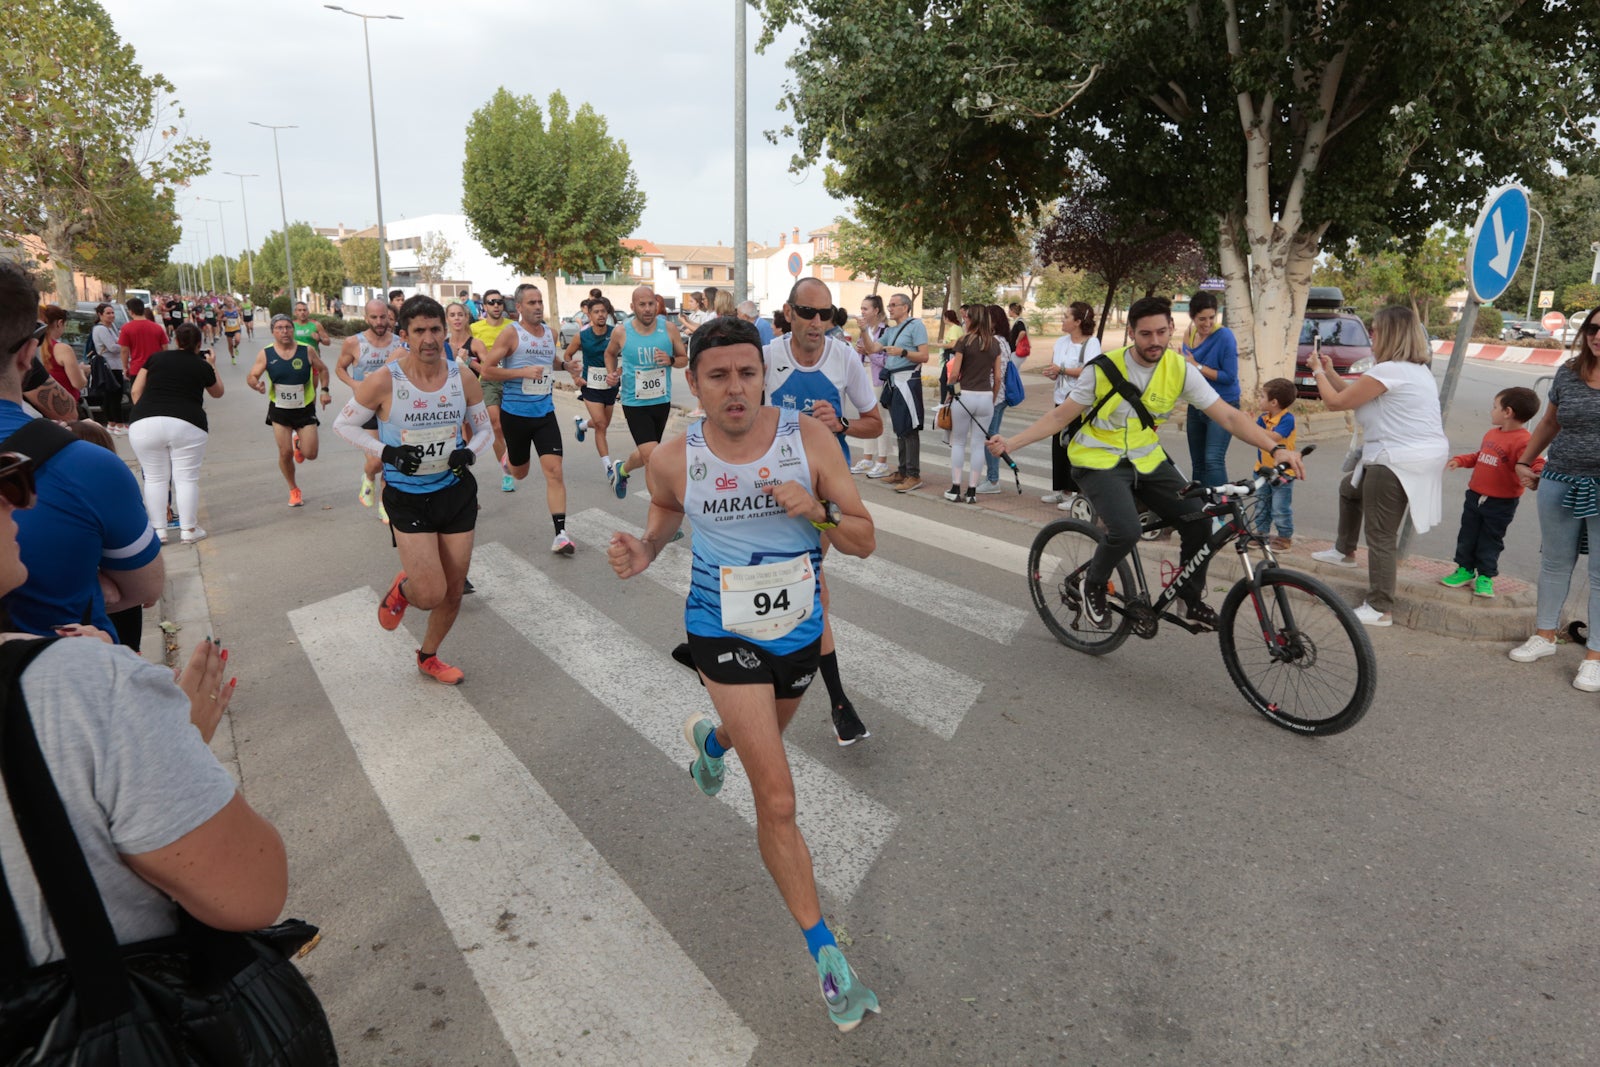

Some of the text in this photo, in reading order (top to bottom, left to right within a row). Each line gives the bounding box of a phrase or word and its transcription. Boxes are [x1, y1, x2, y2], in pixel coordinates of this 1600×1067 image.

[593, 373, 607, 382] 697
[642, 378, 660, 390] 306
[280, 392, 297, 401] 651
[404, 410, 461, 422] MARACENA
[414, 441, 446, 459] 847
[715, 472, 738, 490] als
[715, 514, 734, 522] CLUB
[736, 513, 745, 521] DE
[753, 588, 791, 616] 94
